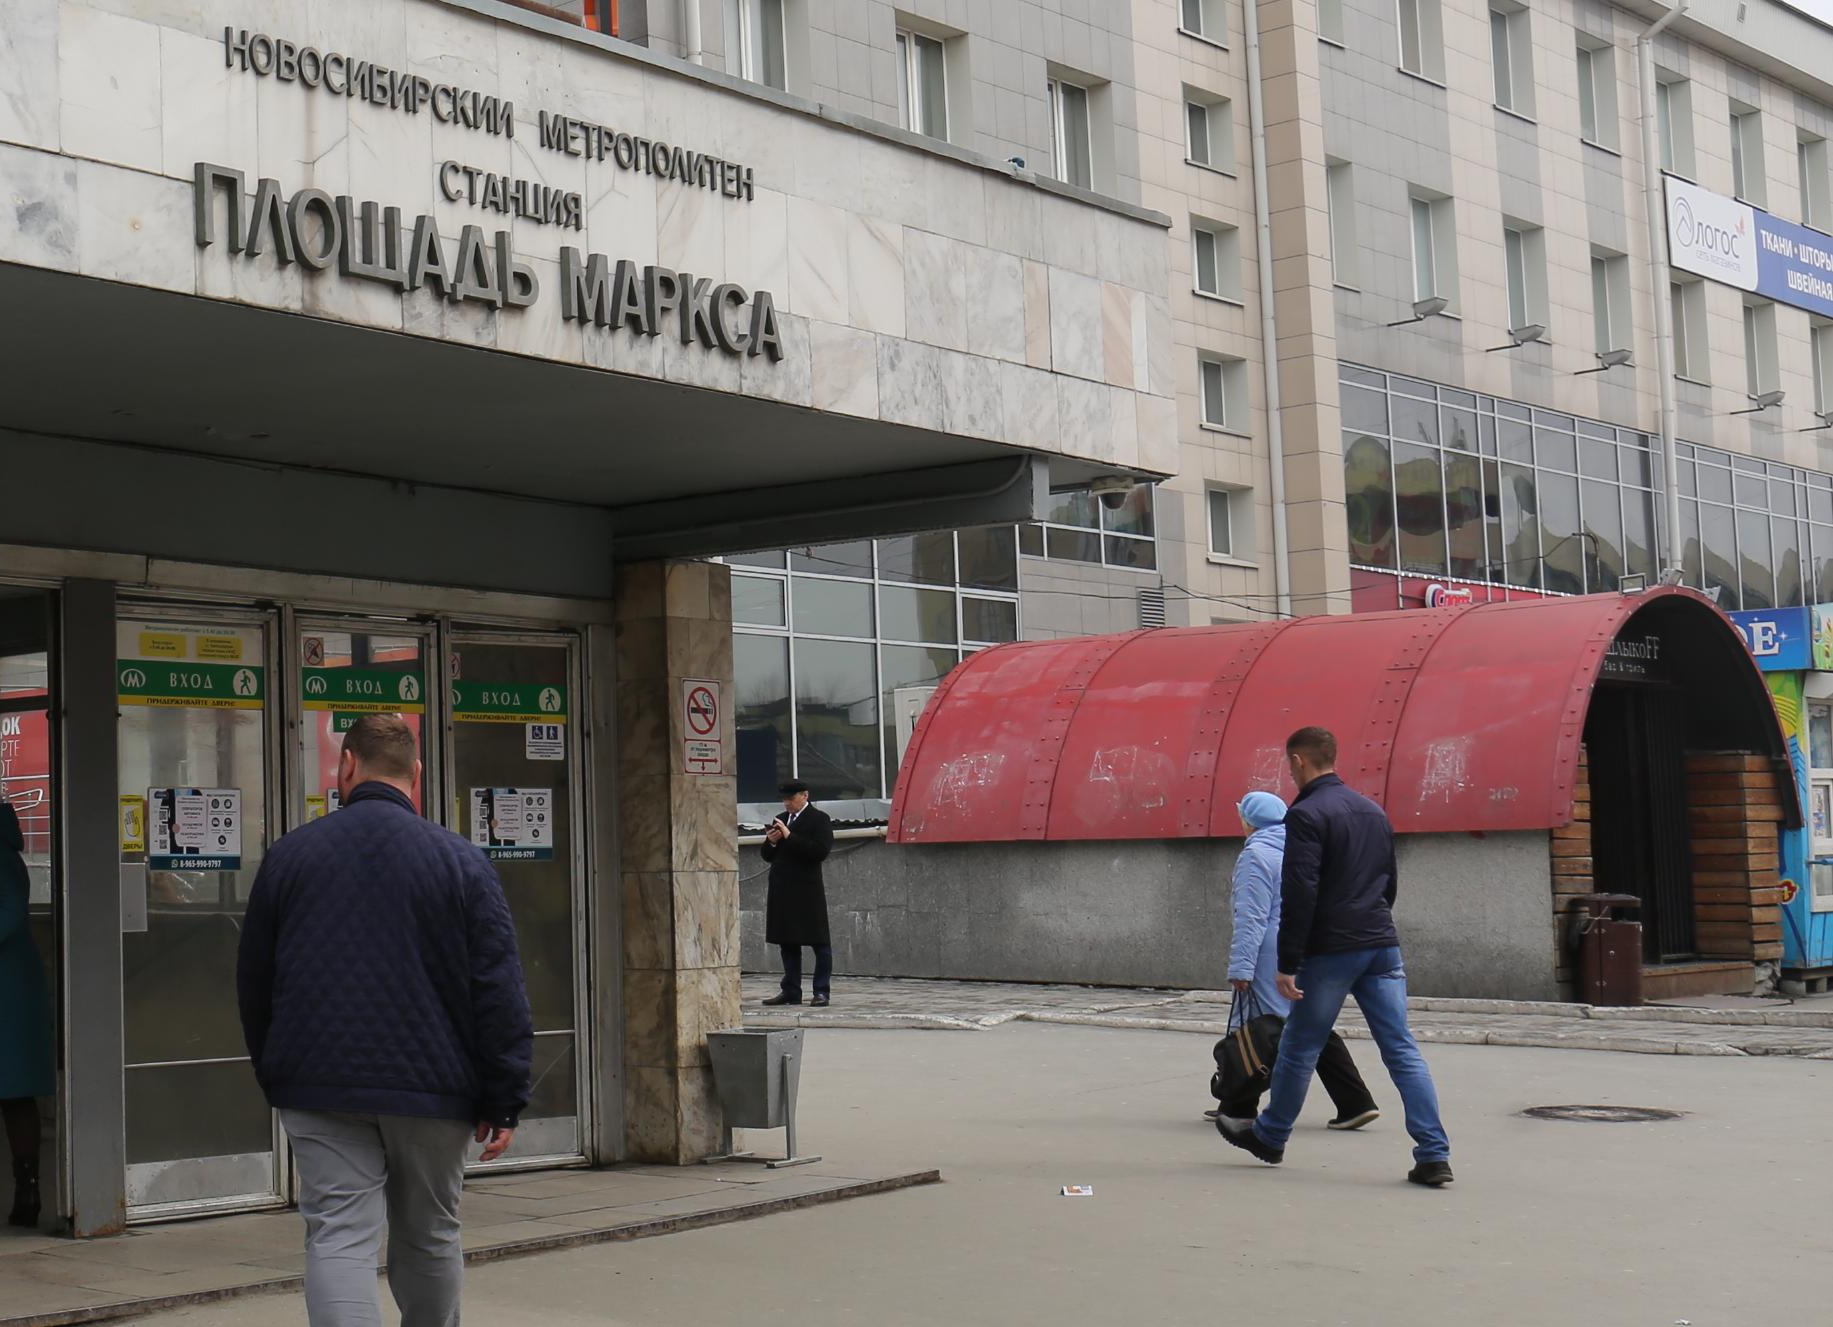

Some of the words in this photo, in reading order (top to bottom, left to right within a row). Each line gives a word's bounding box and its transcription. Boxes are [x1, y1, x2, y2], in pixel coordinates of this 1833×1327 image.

[539, 109, 755, 200] МЕТРОПОЛИТЕН
[440, 160, 583, 230] СТАНЦИЯ
[1760, 230, 1794, 259] ТКАНИ
[194, 162, 539, 310] ПЛОЩАДЬ
[560, 246, 784, 362] МАРКСА
[1787, 269, 1833, 301] ШВЕЙНАЯ
[169, 672, 214, 689] ВХОД
[346, 679, 383, 695] ВХОД
[146, 697, 208, 706] ПРИДЕРЖИВАЙТЕ
[482, 691, 521, 706] ВХОД
[180, 859, 222, 869] 8-965-990-9797
